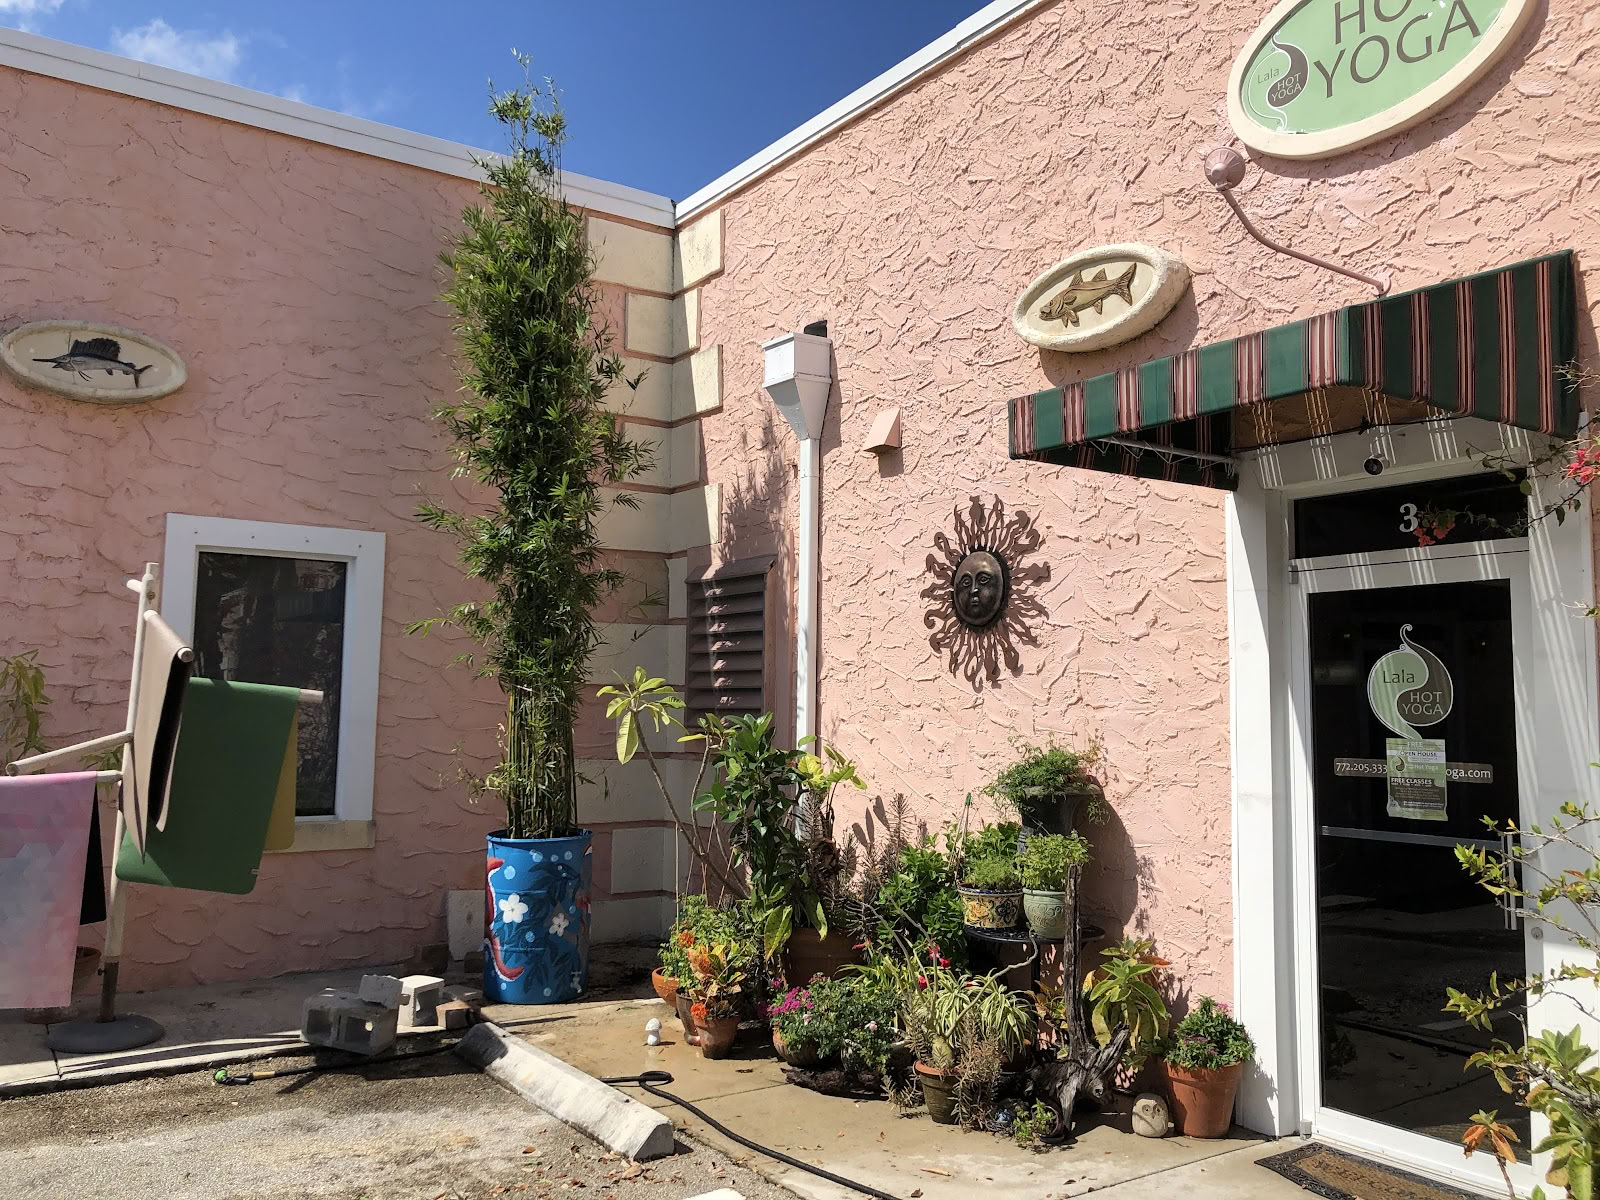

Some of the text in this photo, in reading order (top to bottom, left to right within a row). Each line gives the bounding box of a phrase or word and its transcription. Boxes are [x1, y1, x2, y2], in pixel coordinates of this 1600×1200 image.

[1313, 0, 1481, 98] YOGA
[1257, 68, 1280, 84] Lala
[1277, 72, 1302, 91] HOT
[1271, 82, 1302, 102] YOGA
[1399, 503, 1418, 532] 3
[1383, 669, 1415, 684] Lala
[1410, 691, 1442, 703] HOT
[1402, 703, 1444, 715] YOGA
[1335, 762, 1491, 780] 772.205.333 oga.com
